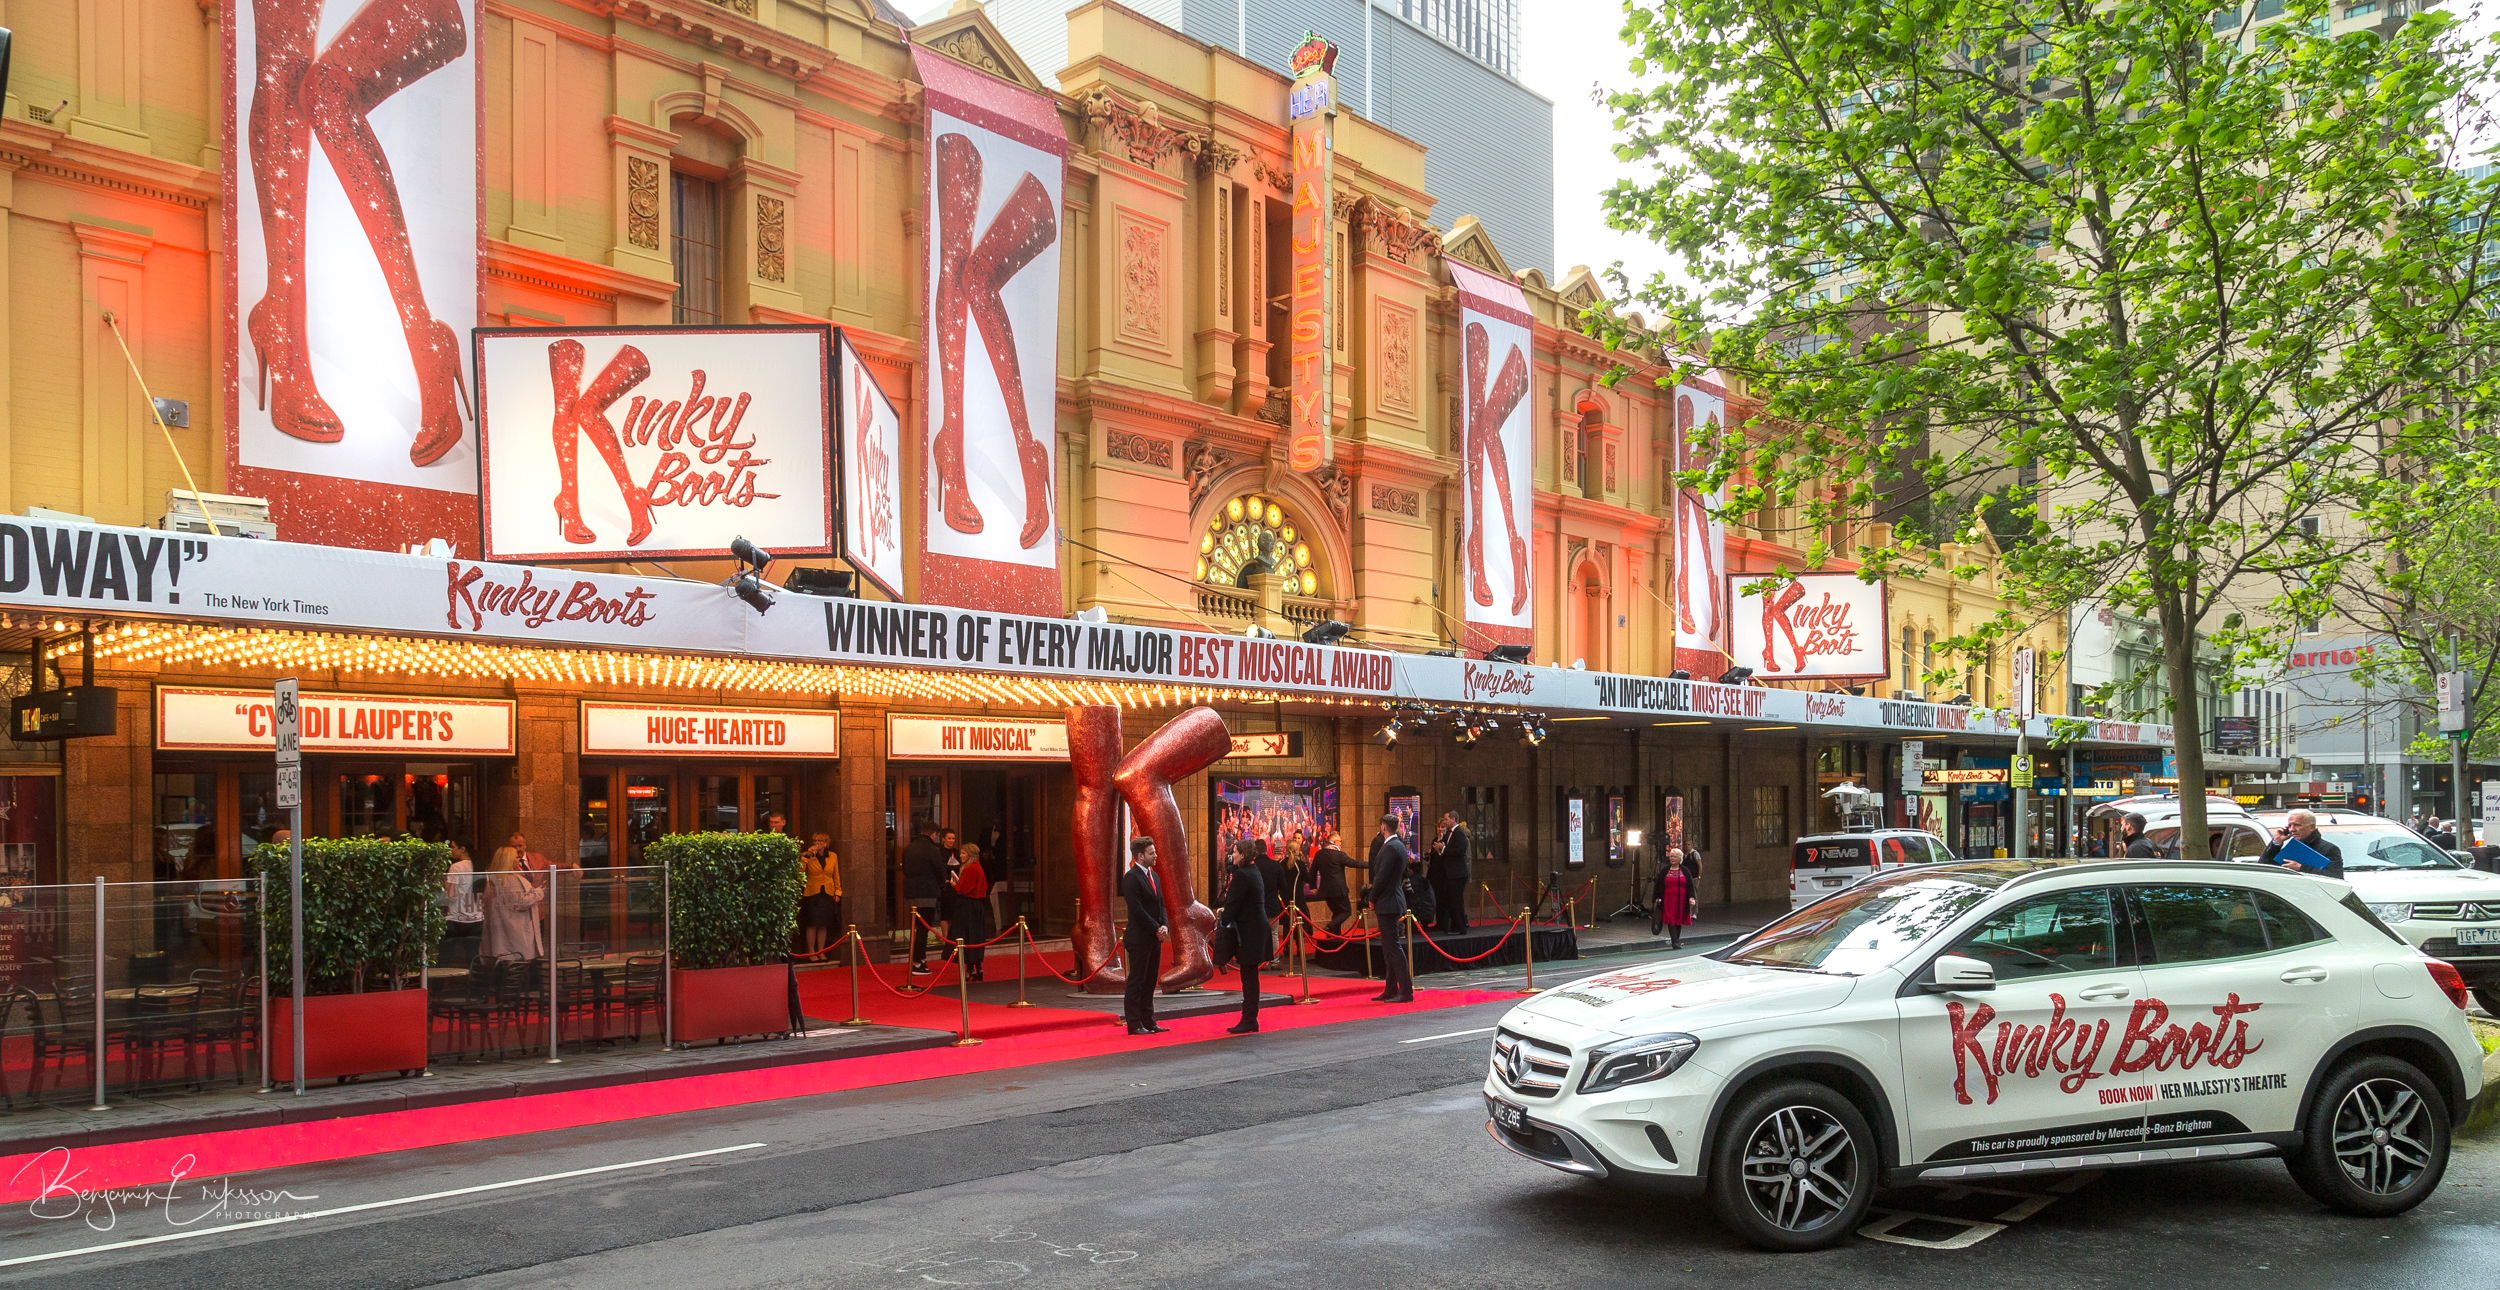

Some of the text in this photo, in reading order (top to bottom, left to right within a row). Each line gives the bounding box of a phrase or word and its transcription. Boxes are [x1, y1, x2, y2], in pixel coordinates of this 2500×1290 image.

[1289, 80, 1329, 120] HER
[548, 338, 757, 546] Kinky
[646, 450, 781, 508] Boots
[204, 592, 329, 615] The New York Times
[447, 562, 658, 632] Kinky Boots
[824, 602, 1392, 692] WINNER OF EVERY MAJOR BEST MUSICAL AWARD
[1803, 629, 1863, 655] Boots
[1464, 661, 1535, 700] Kinky Boots
[1619, 678, 1689, 711] IMPECCABLE
[1692, 684, 1741, 716] MUST-SEE
[235, 703, 454, 742] “CYDI LAUPER’S
[647, 716, 786, 746] HUGE-HEARTED
[942, 726, 1036, 751] HIT MUSICAL”
[277, 732, 298, 752] LANE
[1946, 992, 2264, 1105] Kinky Boots
[2098, 1073, 2288, 1105] BOOK NOW HER MAJESTY’S THEATRE
[1971, 1120, 2212, 1152] This car is proudly sponsored by Mercedes-Benz Brighton
